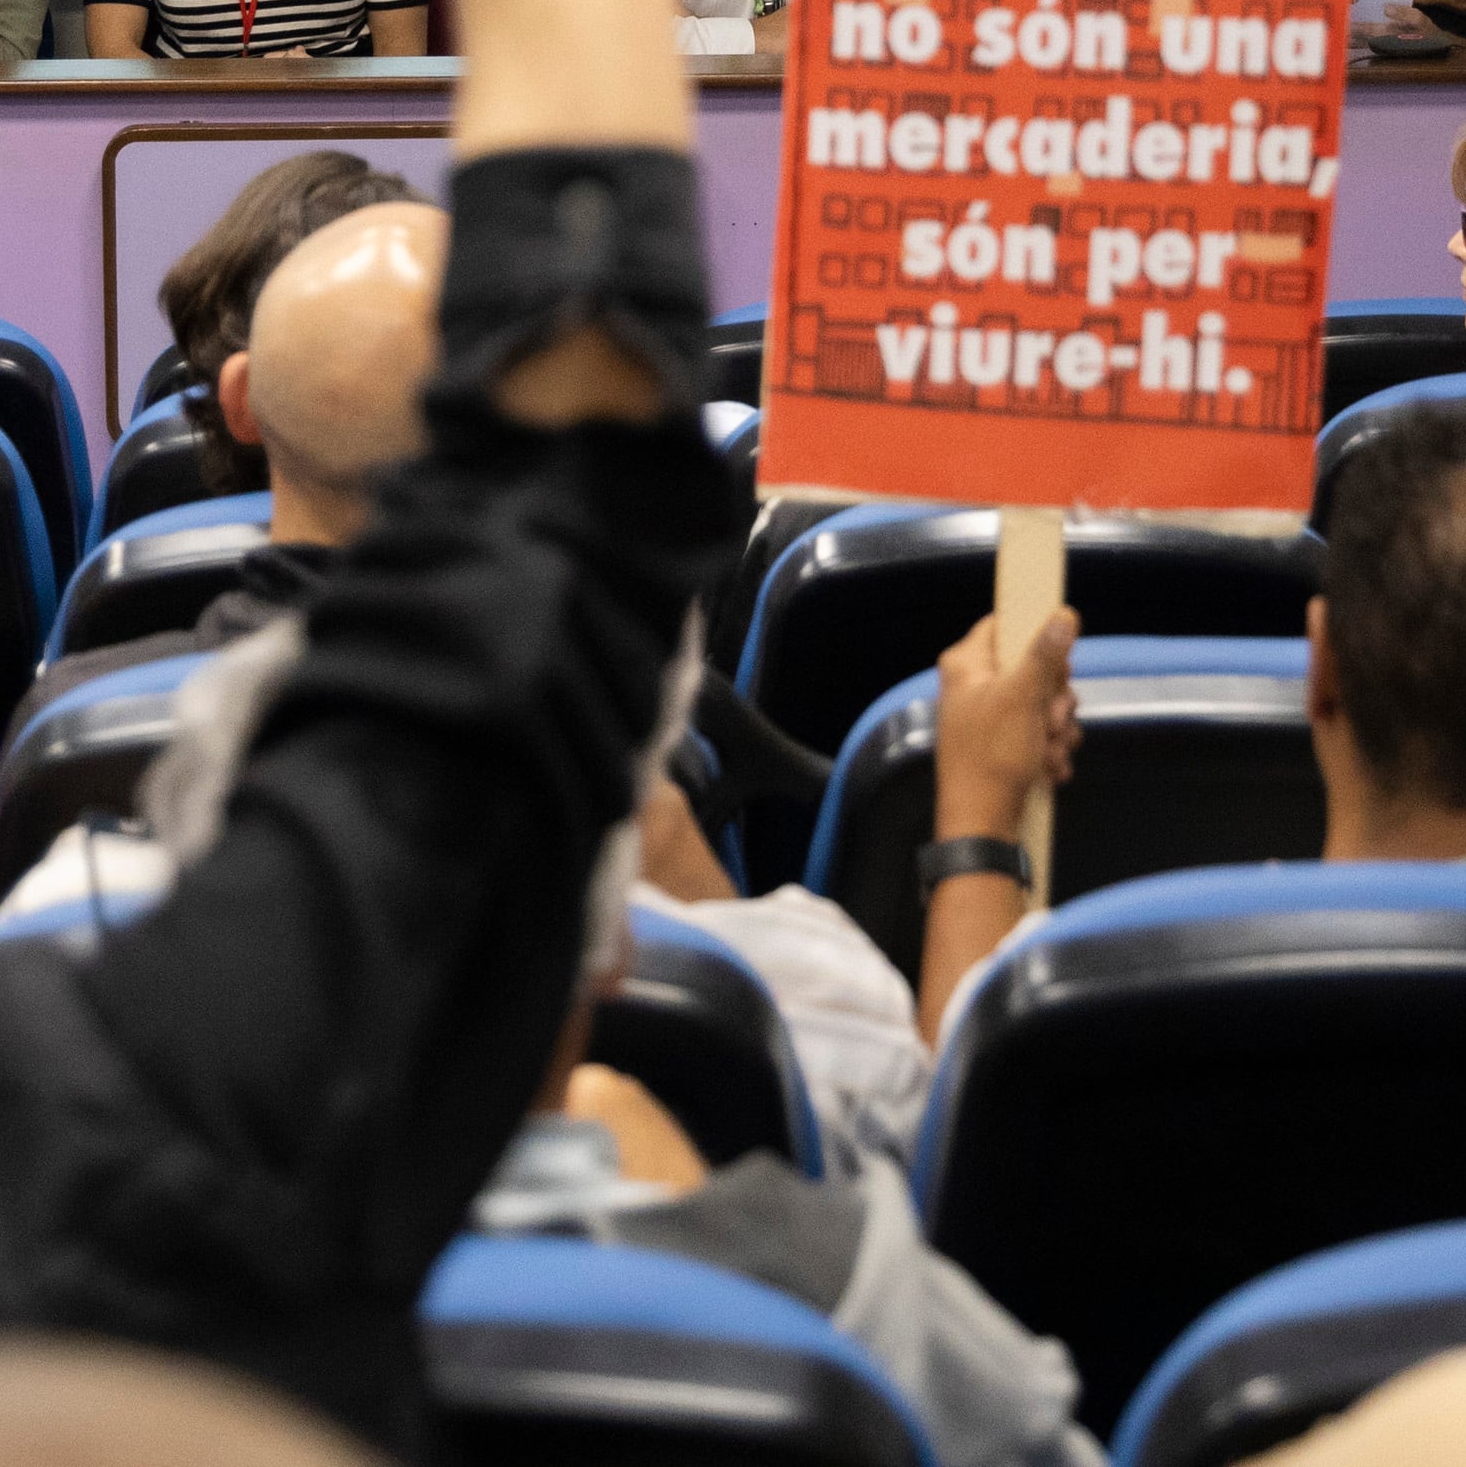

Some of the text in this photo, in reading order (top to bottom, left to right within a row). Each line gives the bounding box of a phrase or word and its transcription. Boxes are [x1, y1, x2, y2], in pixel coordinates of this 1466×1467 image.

[834, 0, 942, 64] no
[1162, 14, 1327, 78] una
[807, 94, 1339, 199] mercaderia,
[902, 200, 1237, 307] són per
[875, 303, 1254, 395] viure-hi.
